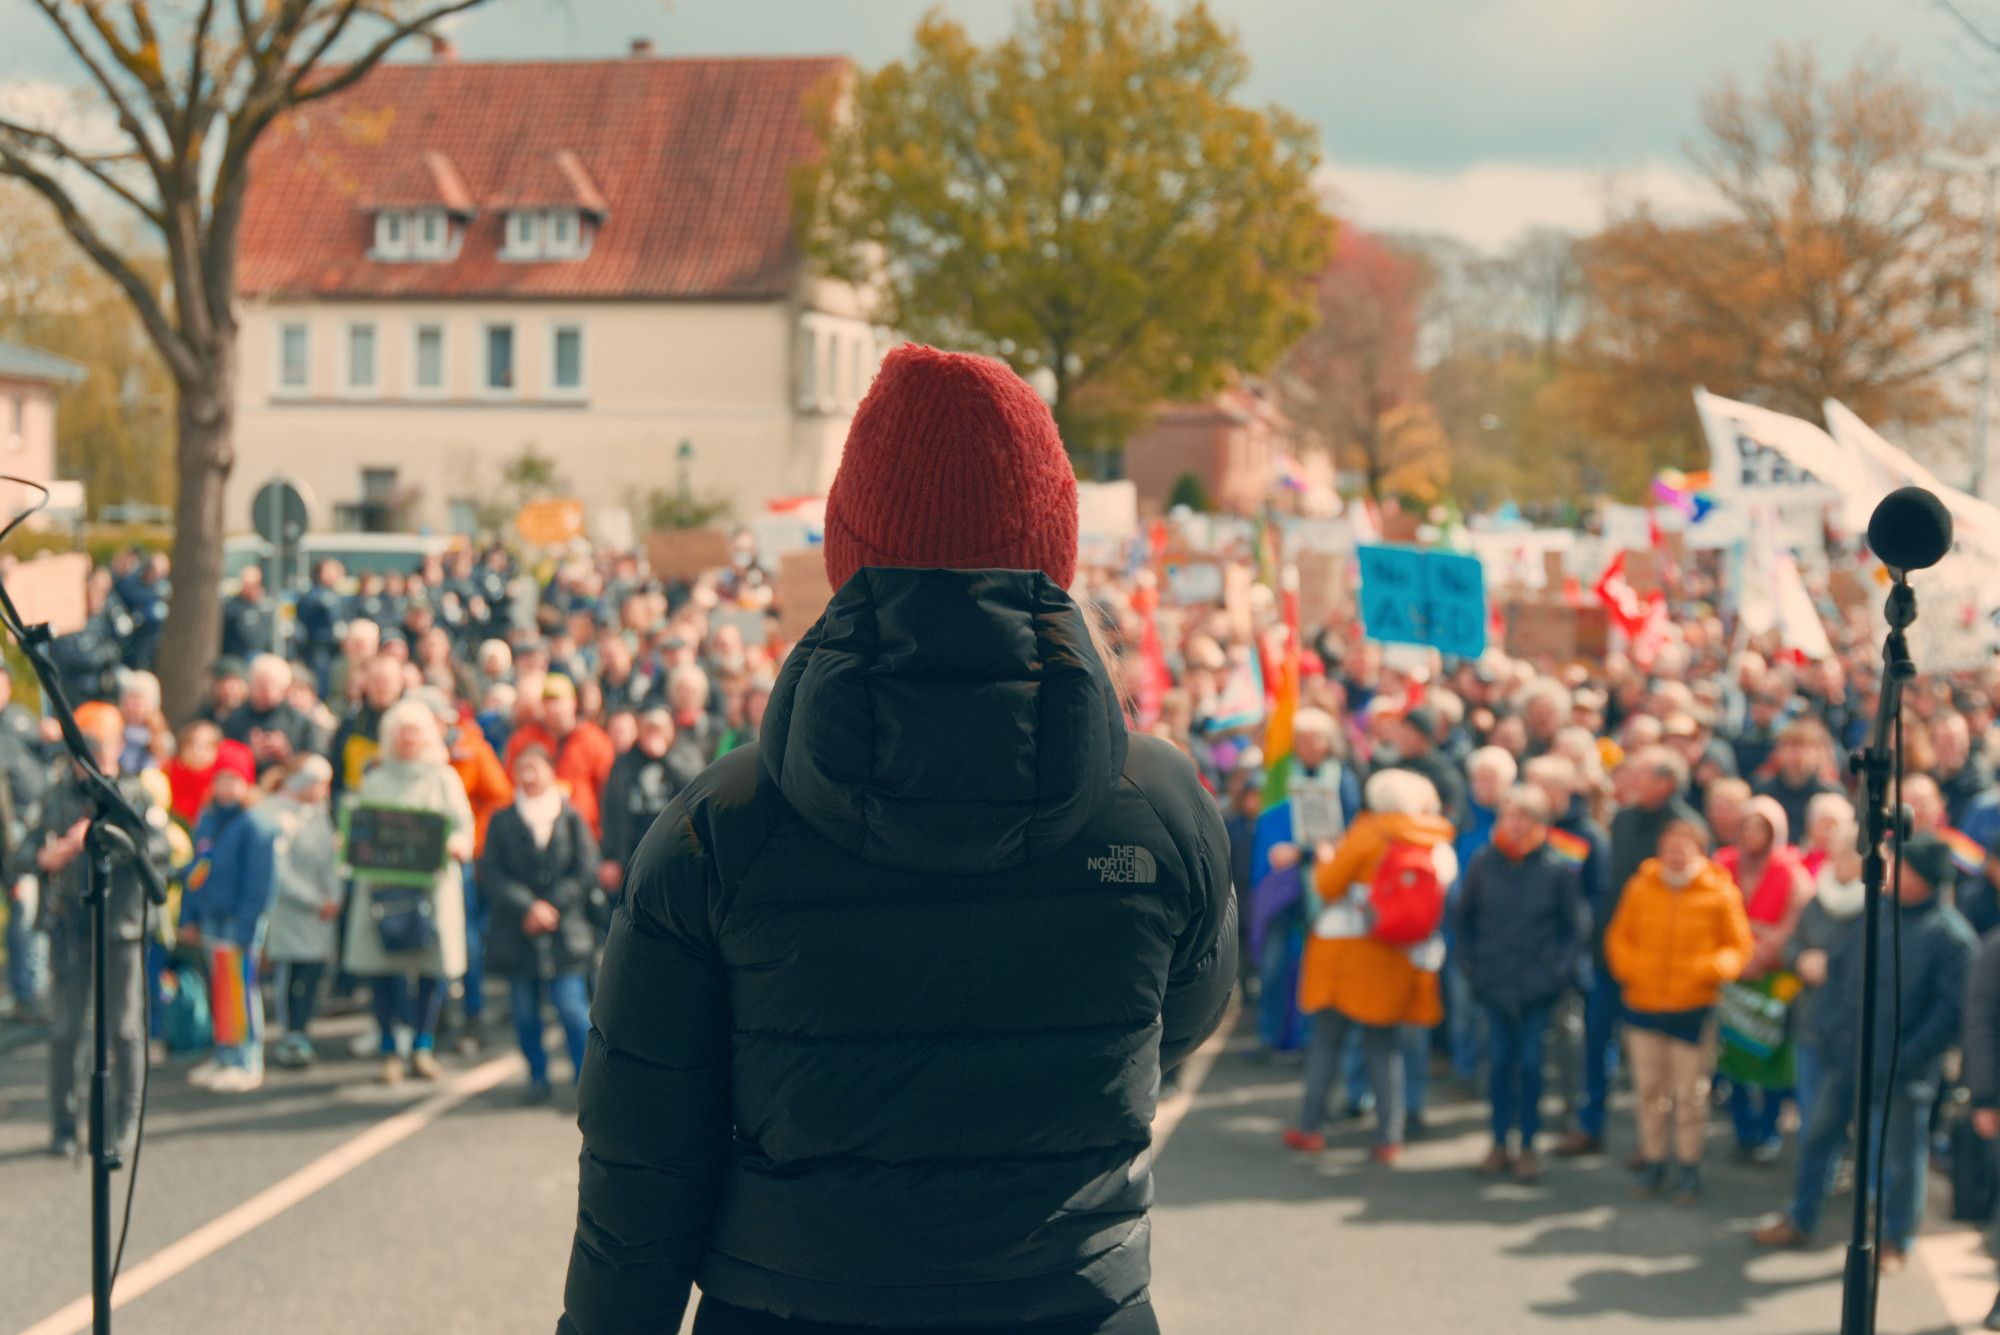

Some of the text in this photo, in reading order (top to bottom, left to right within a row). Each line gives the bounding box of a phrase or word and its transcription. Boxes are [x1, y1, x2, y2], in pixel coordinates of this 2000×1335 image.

[1108, 844, 1135, 858] THE
[1087, 857, 1135, 870] NORTH
[1100, 870, 1135, 883] FACE
